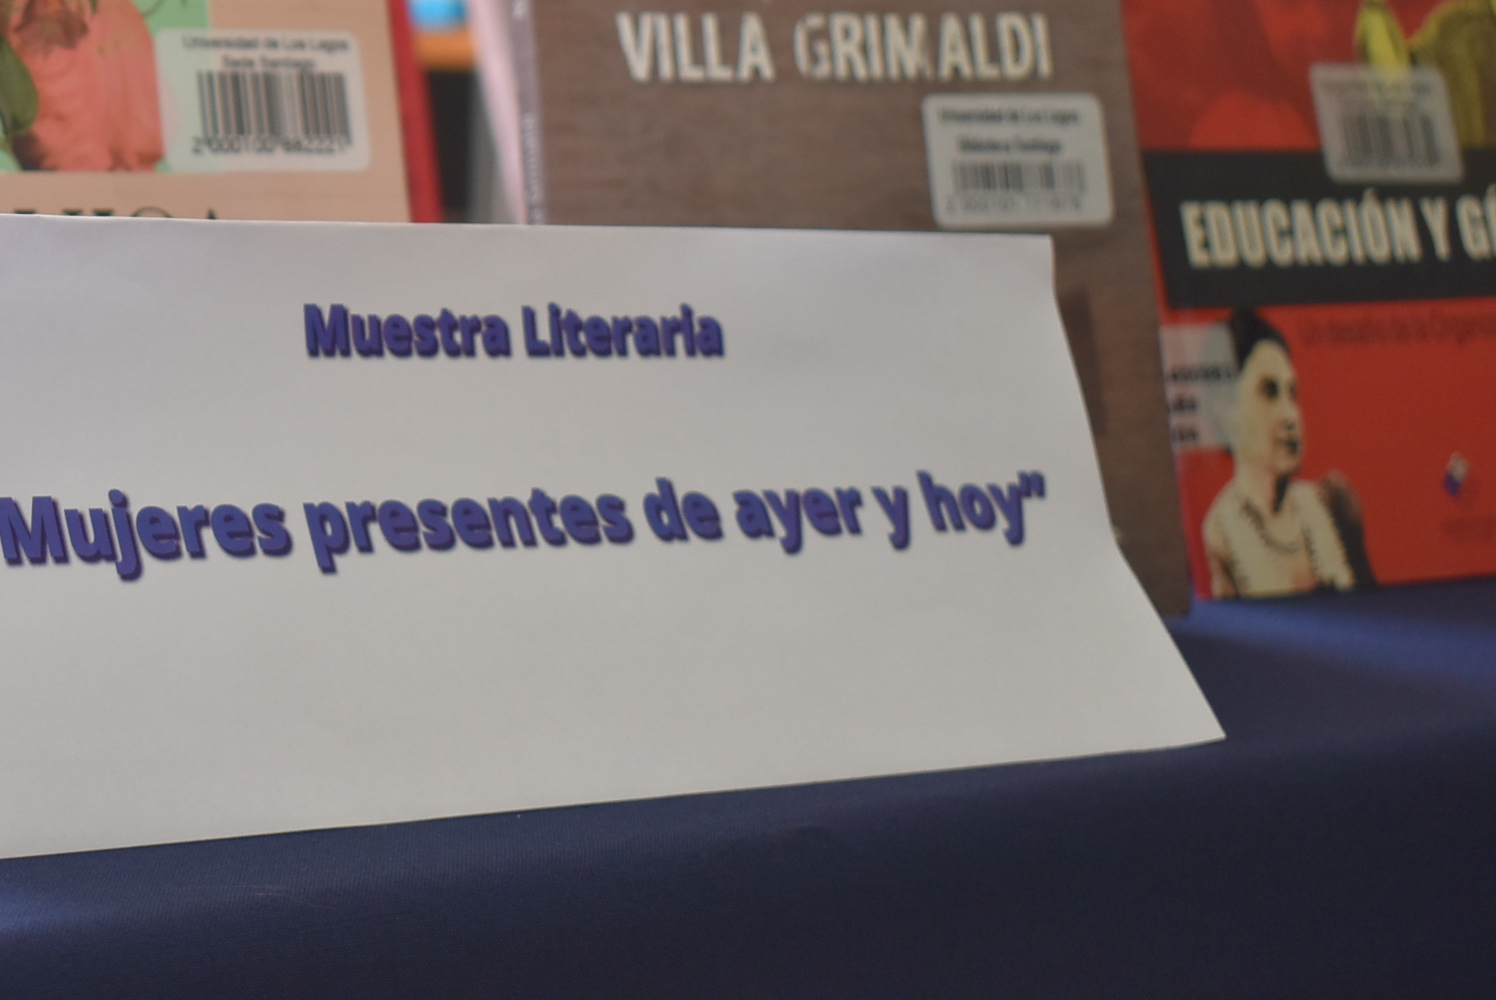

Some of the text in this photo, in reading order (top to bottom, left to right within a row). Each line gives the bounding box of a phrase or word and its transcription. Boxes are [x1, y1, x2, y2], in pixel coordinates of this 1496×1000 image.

[615, 12, 1053, 83] VILLA GRIMALDI
[1181, 187, 1421, 268] EDUCACIÓN
[1421, 198, 1451, 263] Y
[303, 302, 724, 359] Muestra Literaria
[303, 487, 636, 575] presentes
[642, 477, 724, 542] de
[732, 487, 863, 555] ayer
[870, 486, 911, 551] y
